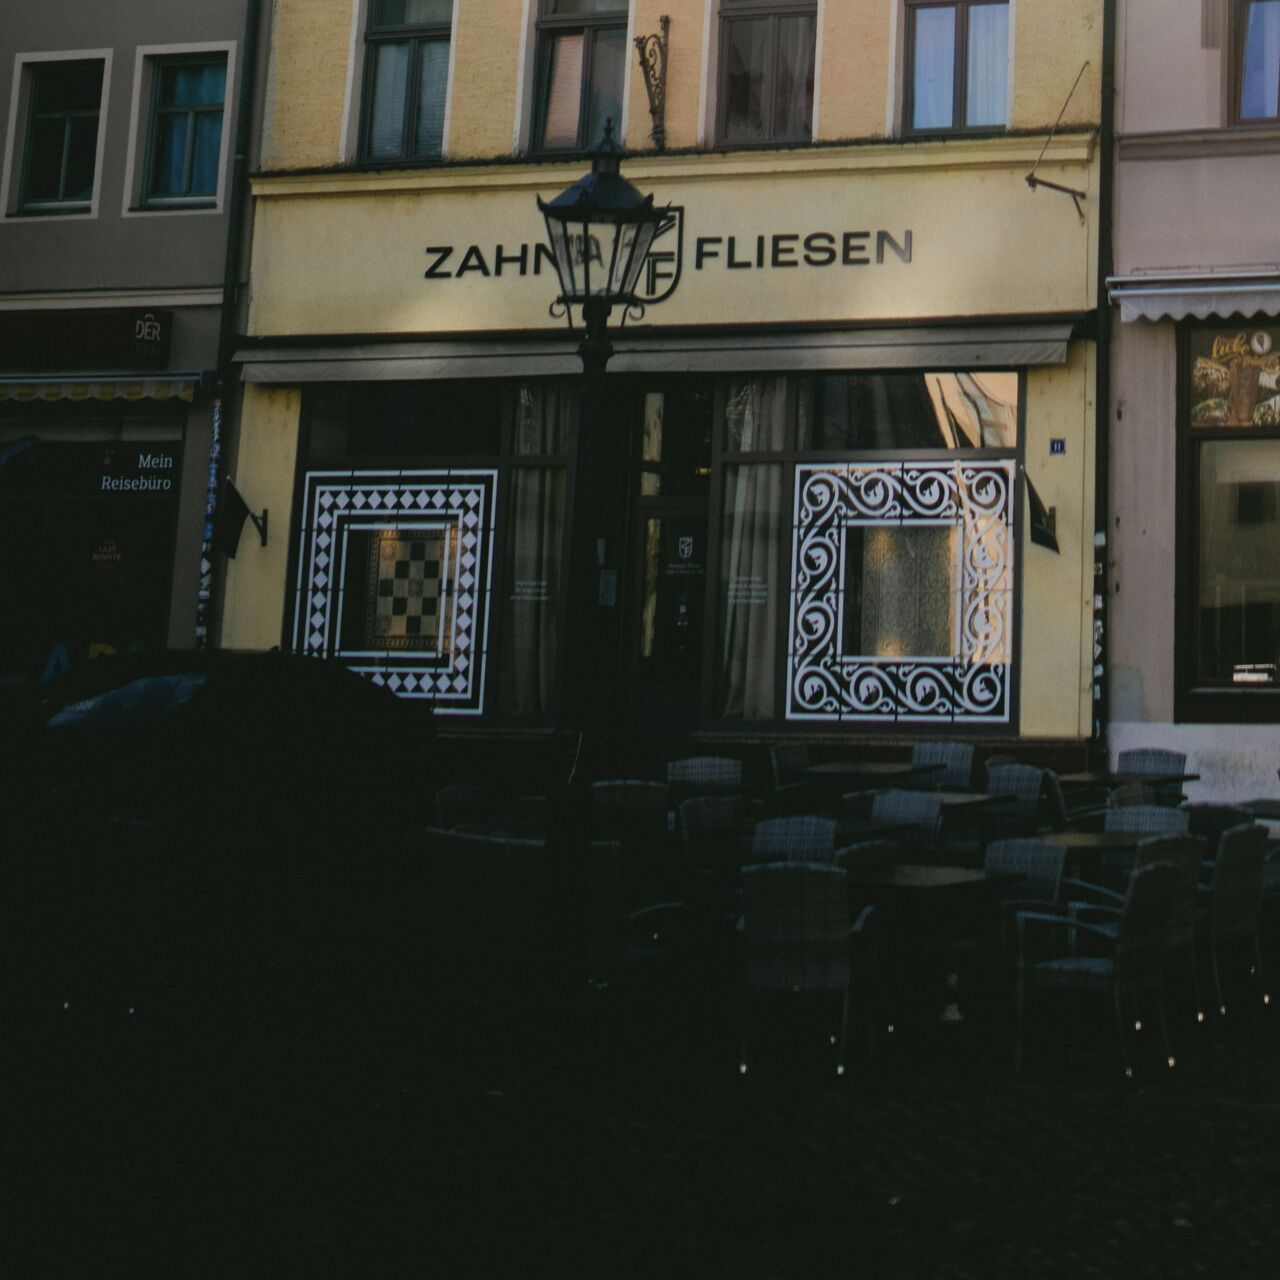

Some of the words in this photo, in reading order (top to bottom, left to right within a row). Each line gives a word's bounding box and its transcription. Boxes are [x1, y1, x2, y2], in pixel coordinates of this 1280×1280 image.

[696, 230, 912, 270] FLIESEN
[136, 320, 160, 341] DER
[1054, 442, 1061, 452] 11
[138, 453, 173, 468] Mein
[101, 475, 172, 490] Reisebüro
